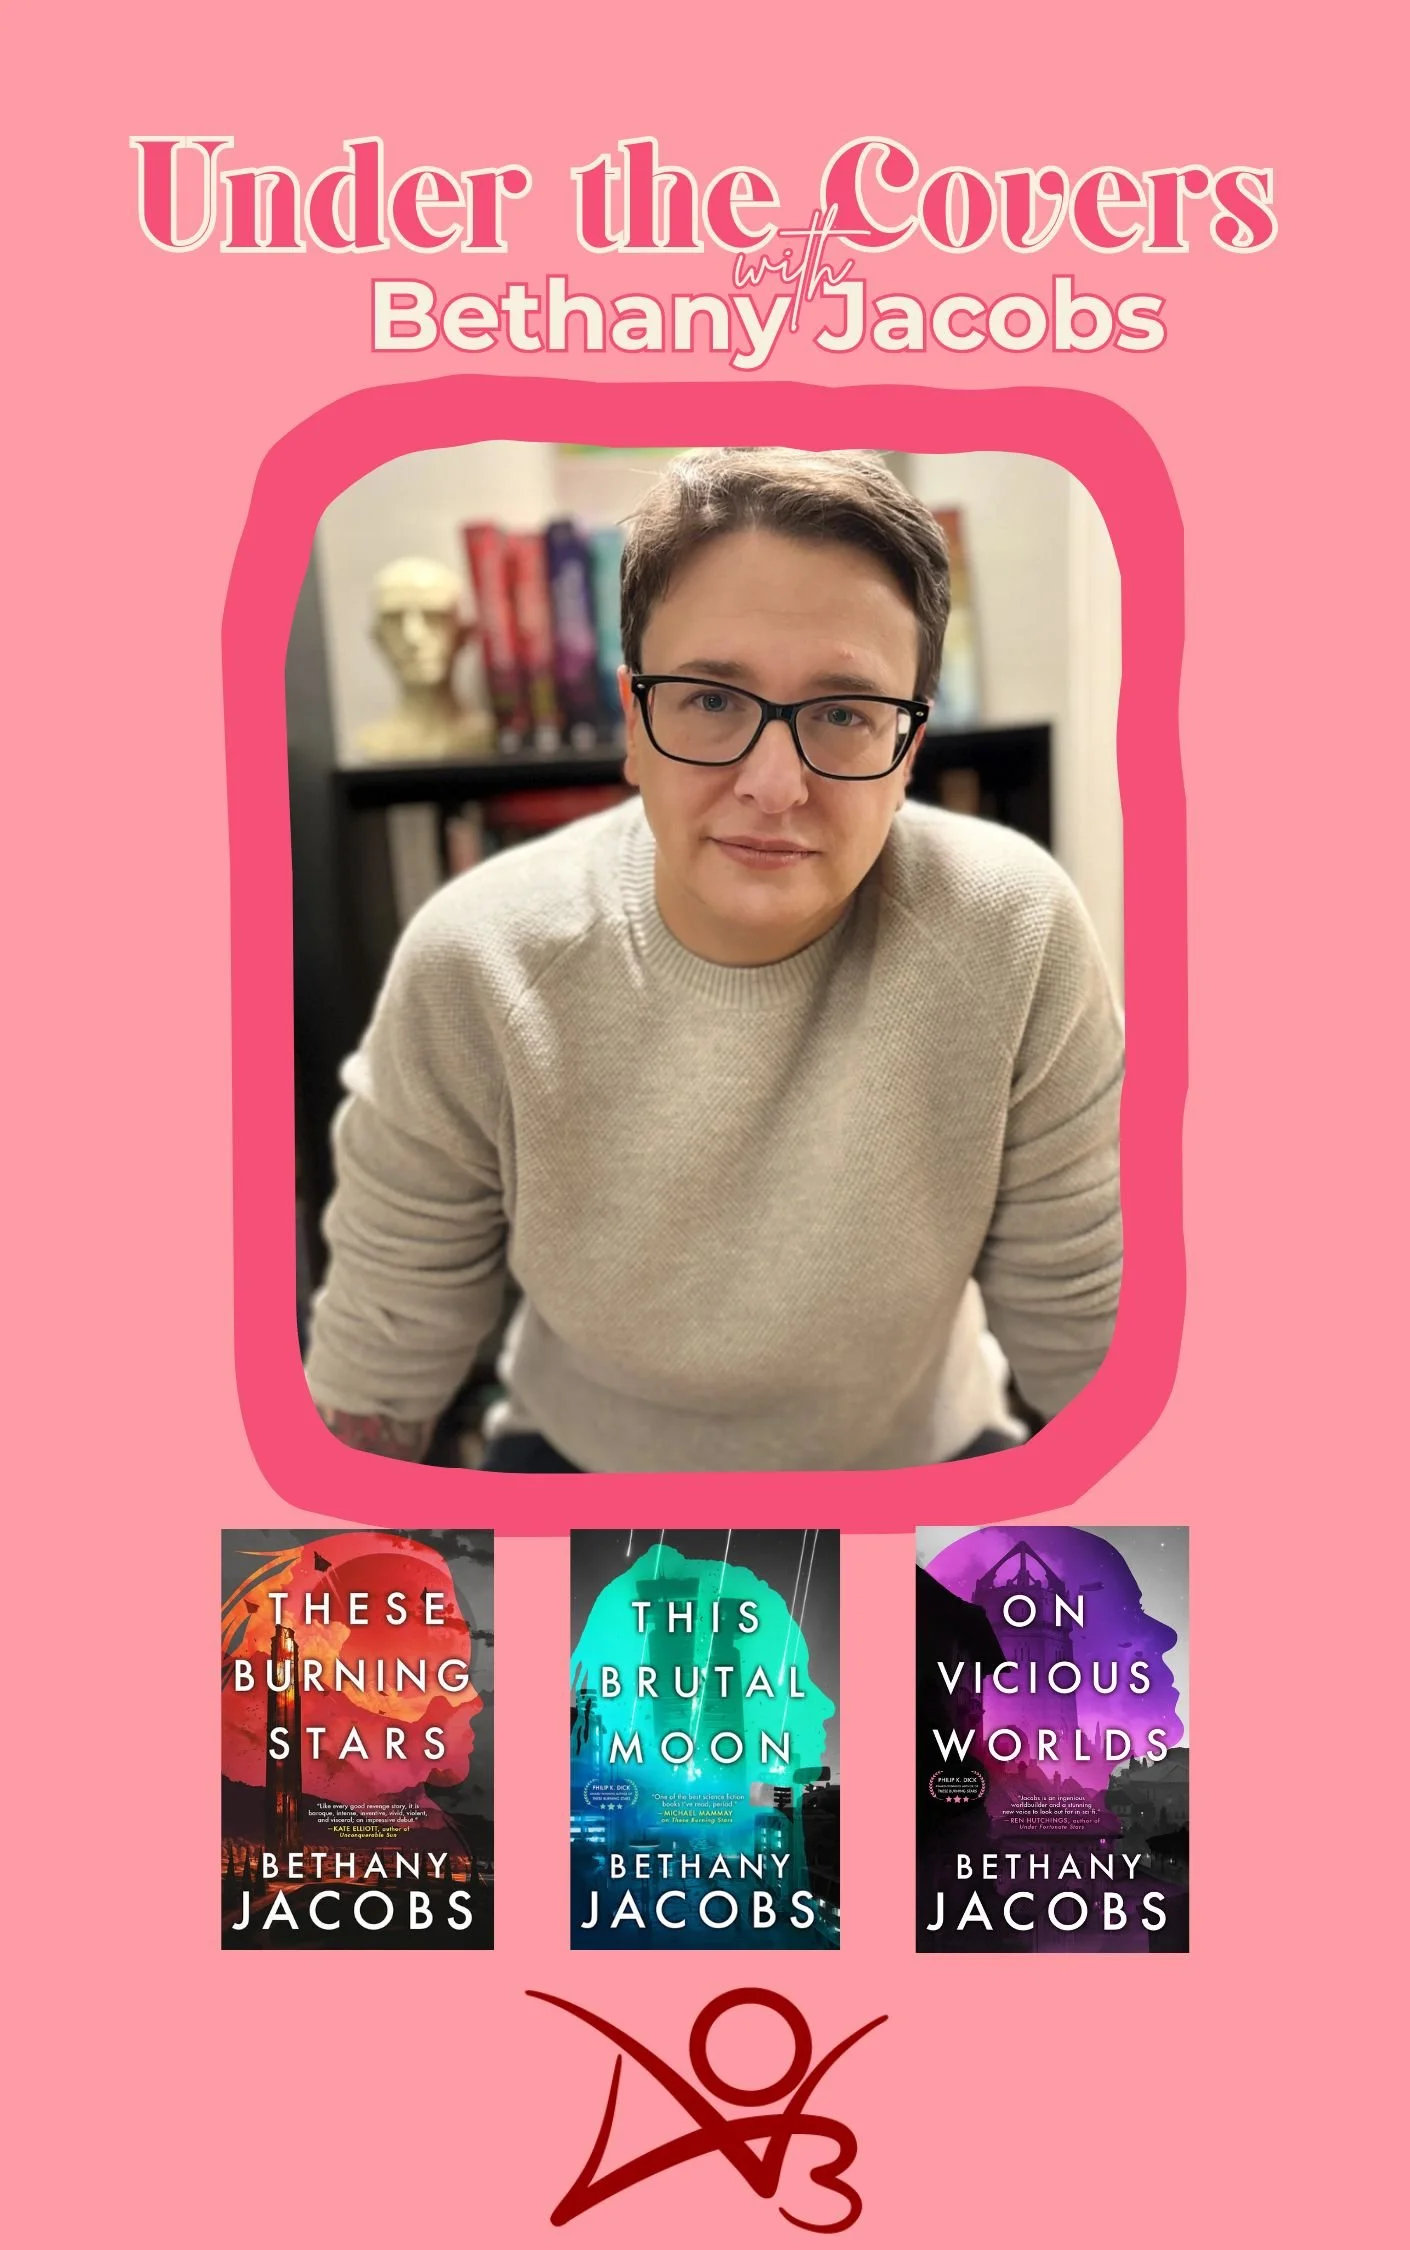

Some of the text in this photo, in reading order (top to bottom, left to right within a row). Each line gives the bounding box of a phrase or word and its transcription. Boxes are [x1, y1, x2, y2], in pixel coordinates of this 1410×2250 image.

[129, 136, 1279, 253] Under the Covers
[732, 202, 872, 333] with
[371, 273, 1167, 370] Bethany Jacobs
[268, 1592, 445, 1625] THESE
[632, 1600, 759, 1633] THIS
[1003, 1594, 1084, 1628] ON
[235, 1659, 469, 1692] BURNING
[601, 1666, 805, 1698] BRUTAL
[937, 1661, 1151, 1694] VICIOUS
[269, 1726, 445, 1760] STARS
[609, 1731, 791, 1764] MOON
[932, 1728, 1168, 1762] WORLDS
[262, 1852, 448, 1879] BETHANY
[610, 1853, 790, 1879] BETHANY
[957, 1853, 1141, 1880] BETHANY
[232, 1890, 473, 1931] JACOBS
[581, 1890, 815, 1929] JACOBS
[927, 1891, 1167, 1931] JACOBS
